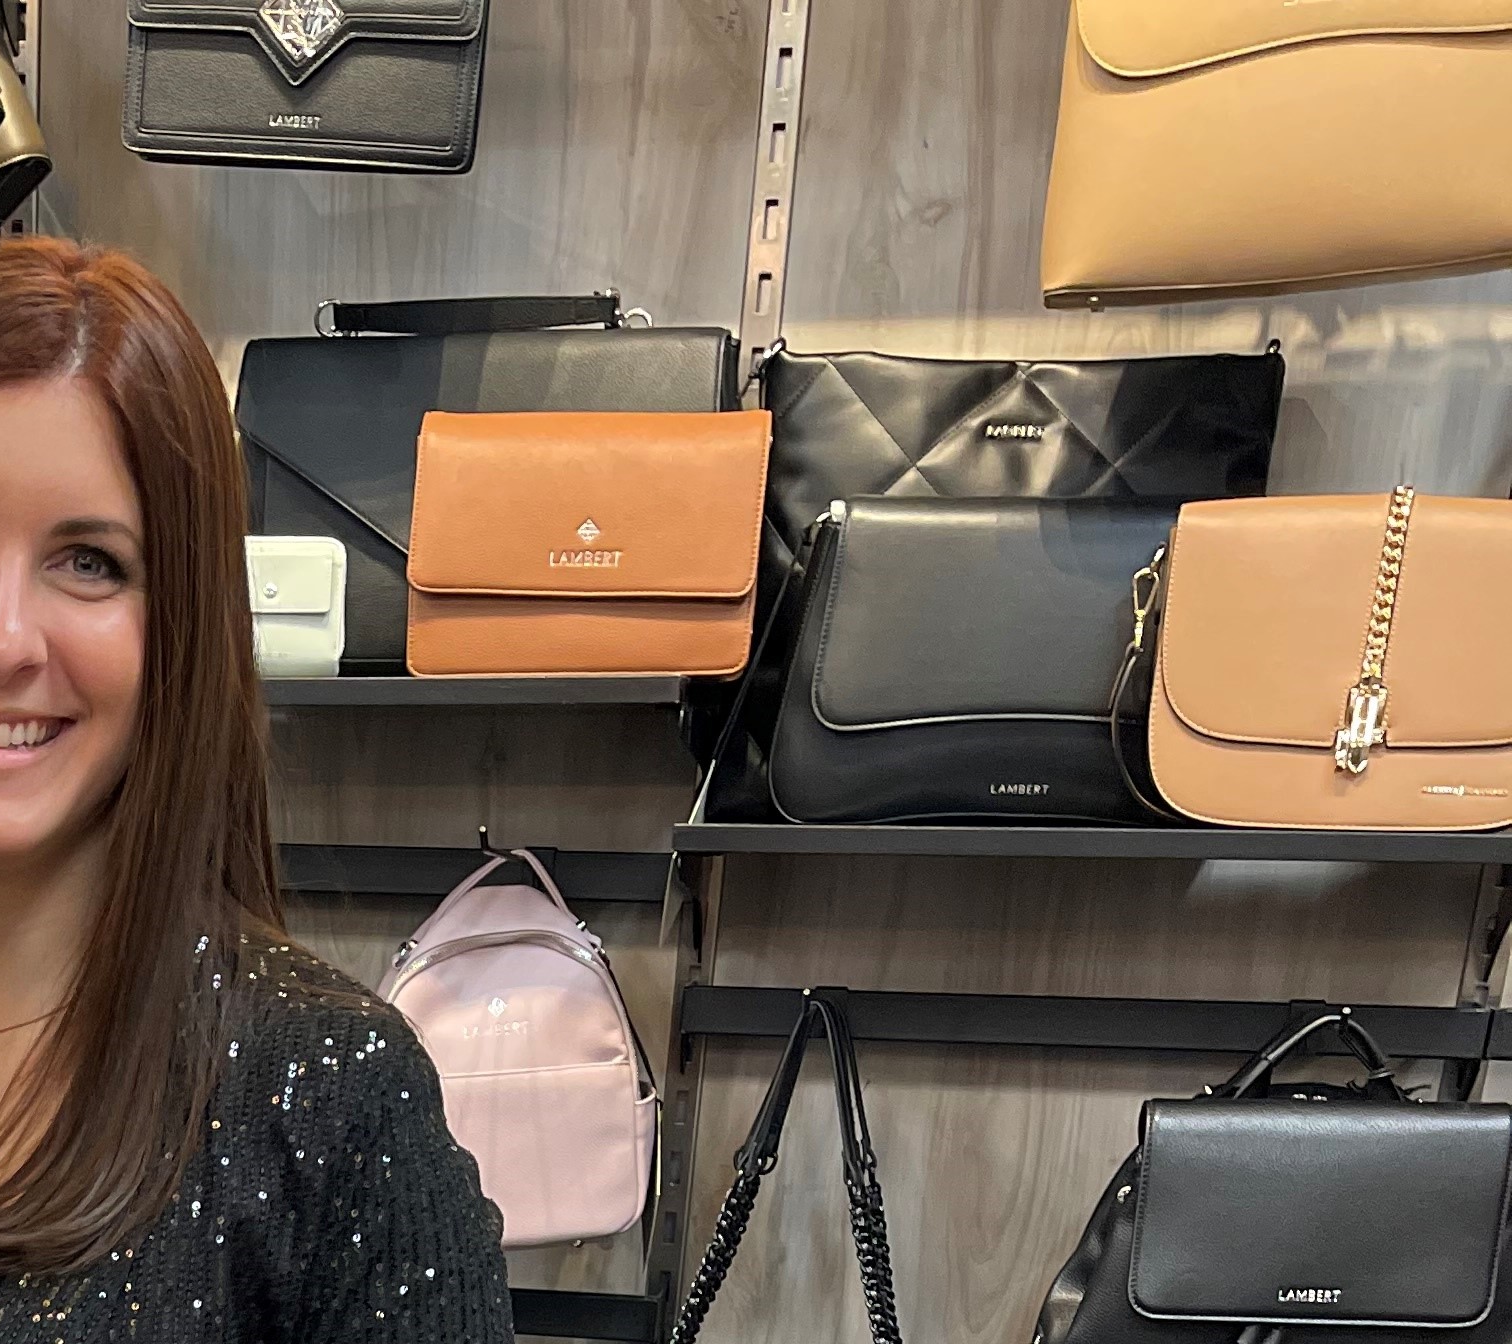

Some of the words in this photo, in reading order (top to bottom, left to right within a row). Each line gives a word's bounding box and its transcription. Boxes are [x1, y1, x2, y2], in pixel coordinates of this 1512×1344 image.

[268, 114, 321, 130] LAMBERT
[549, 550, 624, 568] LAMBERT
[990, 783, 1050, 796] LAMBERT
[1278, 1288, 1342, 1304] LAMBERT
